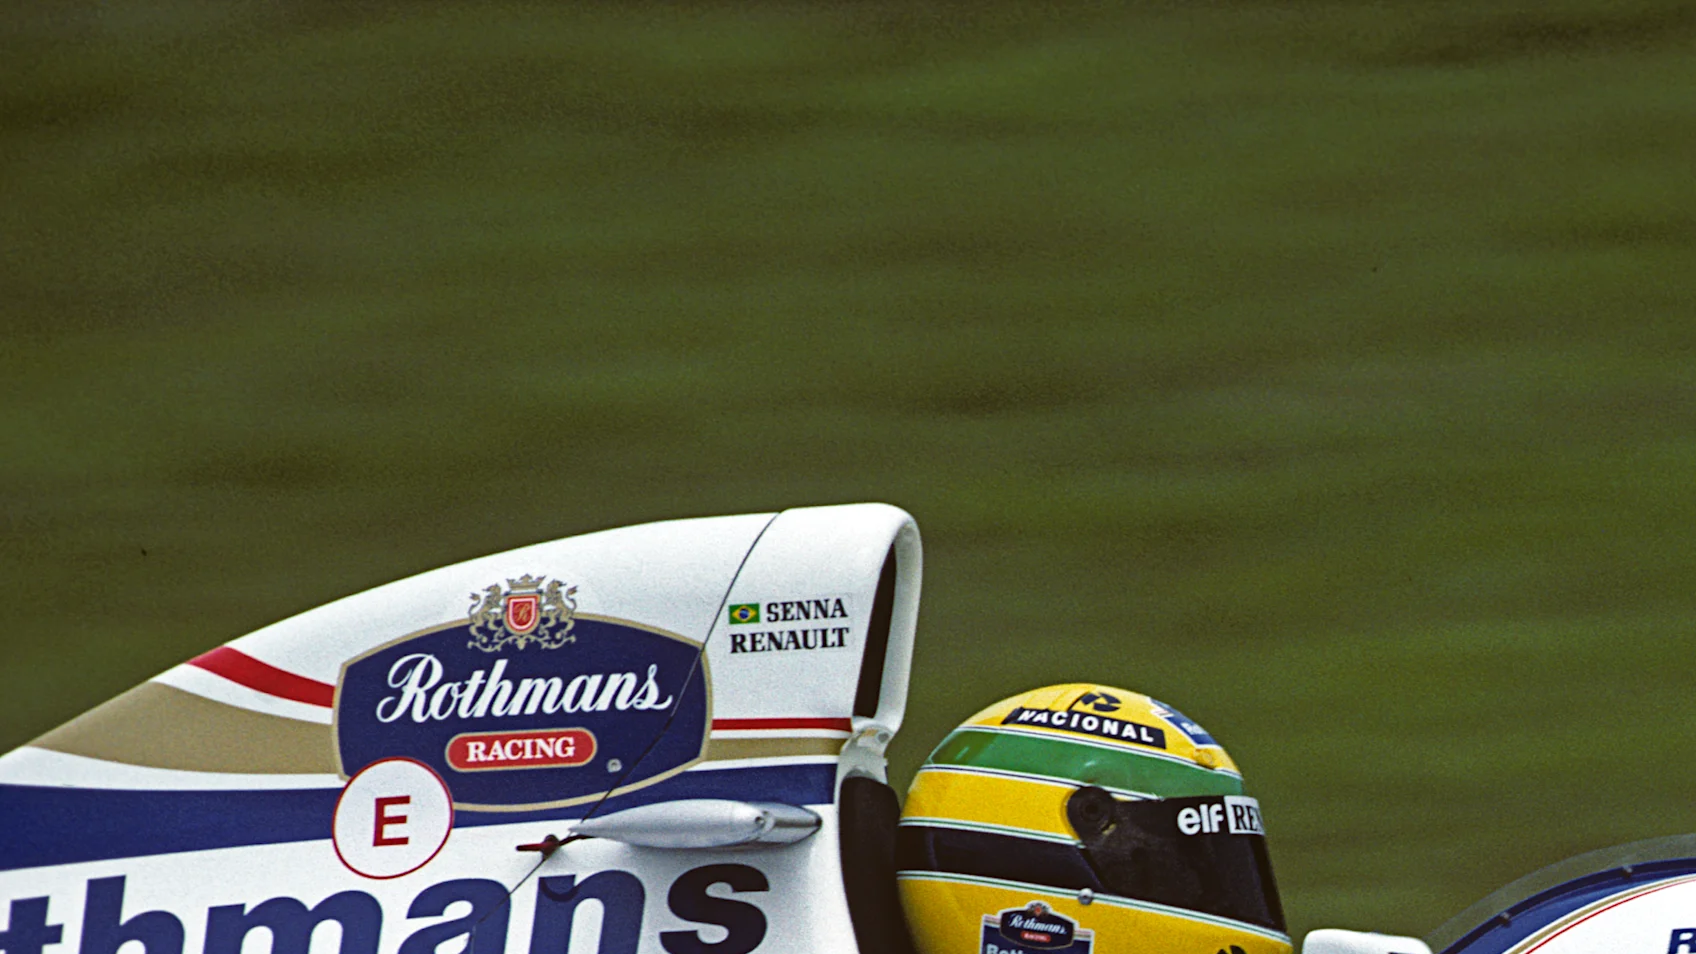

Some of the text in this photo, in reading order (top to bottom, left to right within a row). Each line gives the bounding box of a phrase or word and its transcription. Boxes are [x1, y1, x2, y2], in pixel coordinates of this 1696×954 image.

[766, 598, 849, 623] SENNA
[730, 627, 850, 654] RENAULT
[376, 653, 673, 723] Rothmans
[1018, 709, 1154, 743] NACIONAL
[466, 736, 576, 763] RACING
[372, 795, 411, 847] E
[1177, 803, 1224, 835] elf
